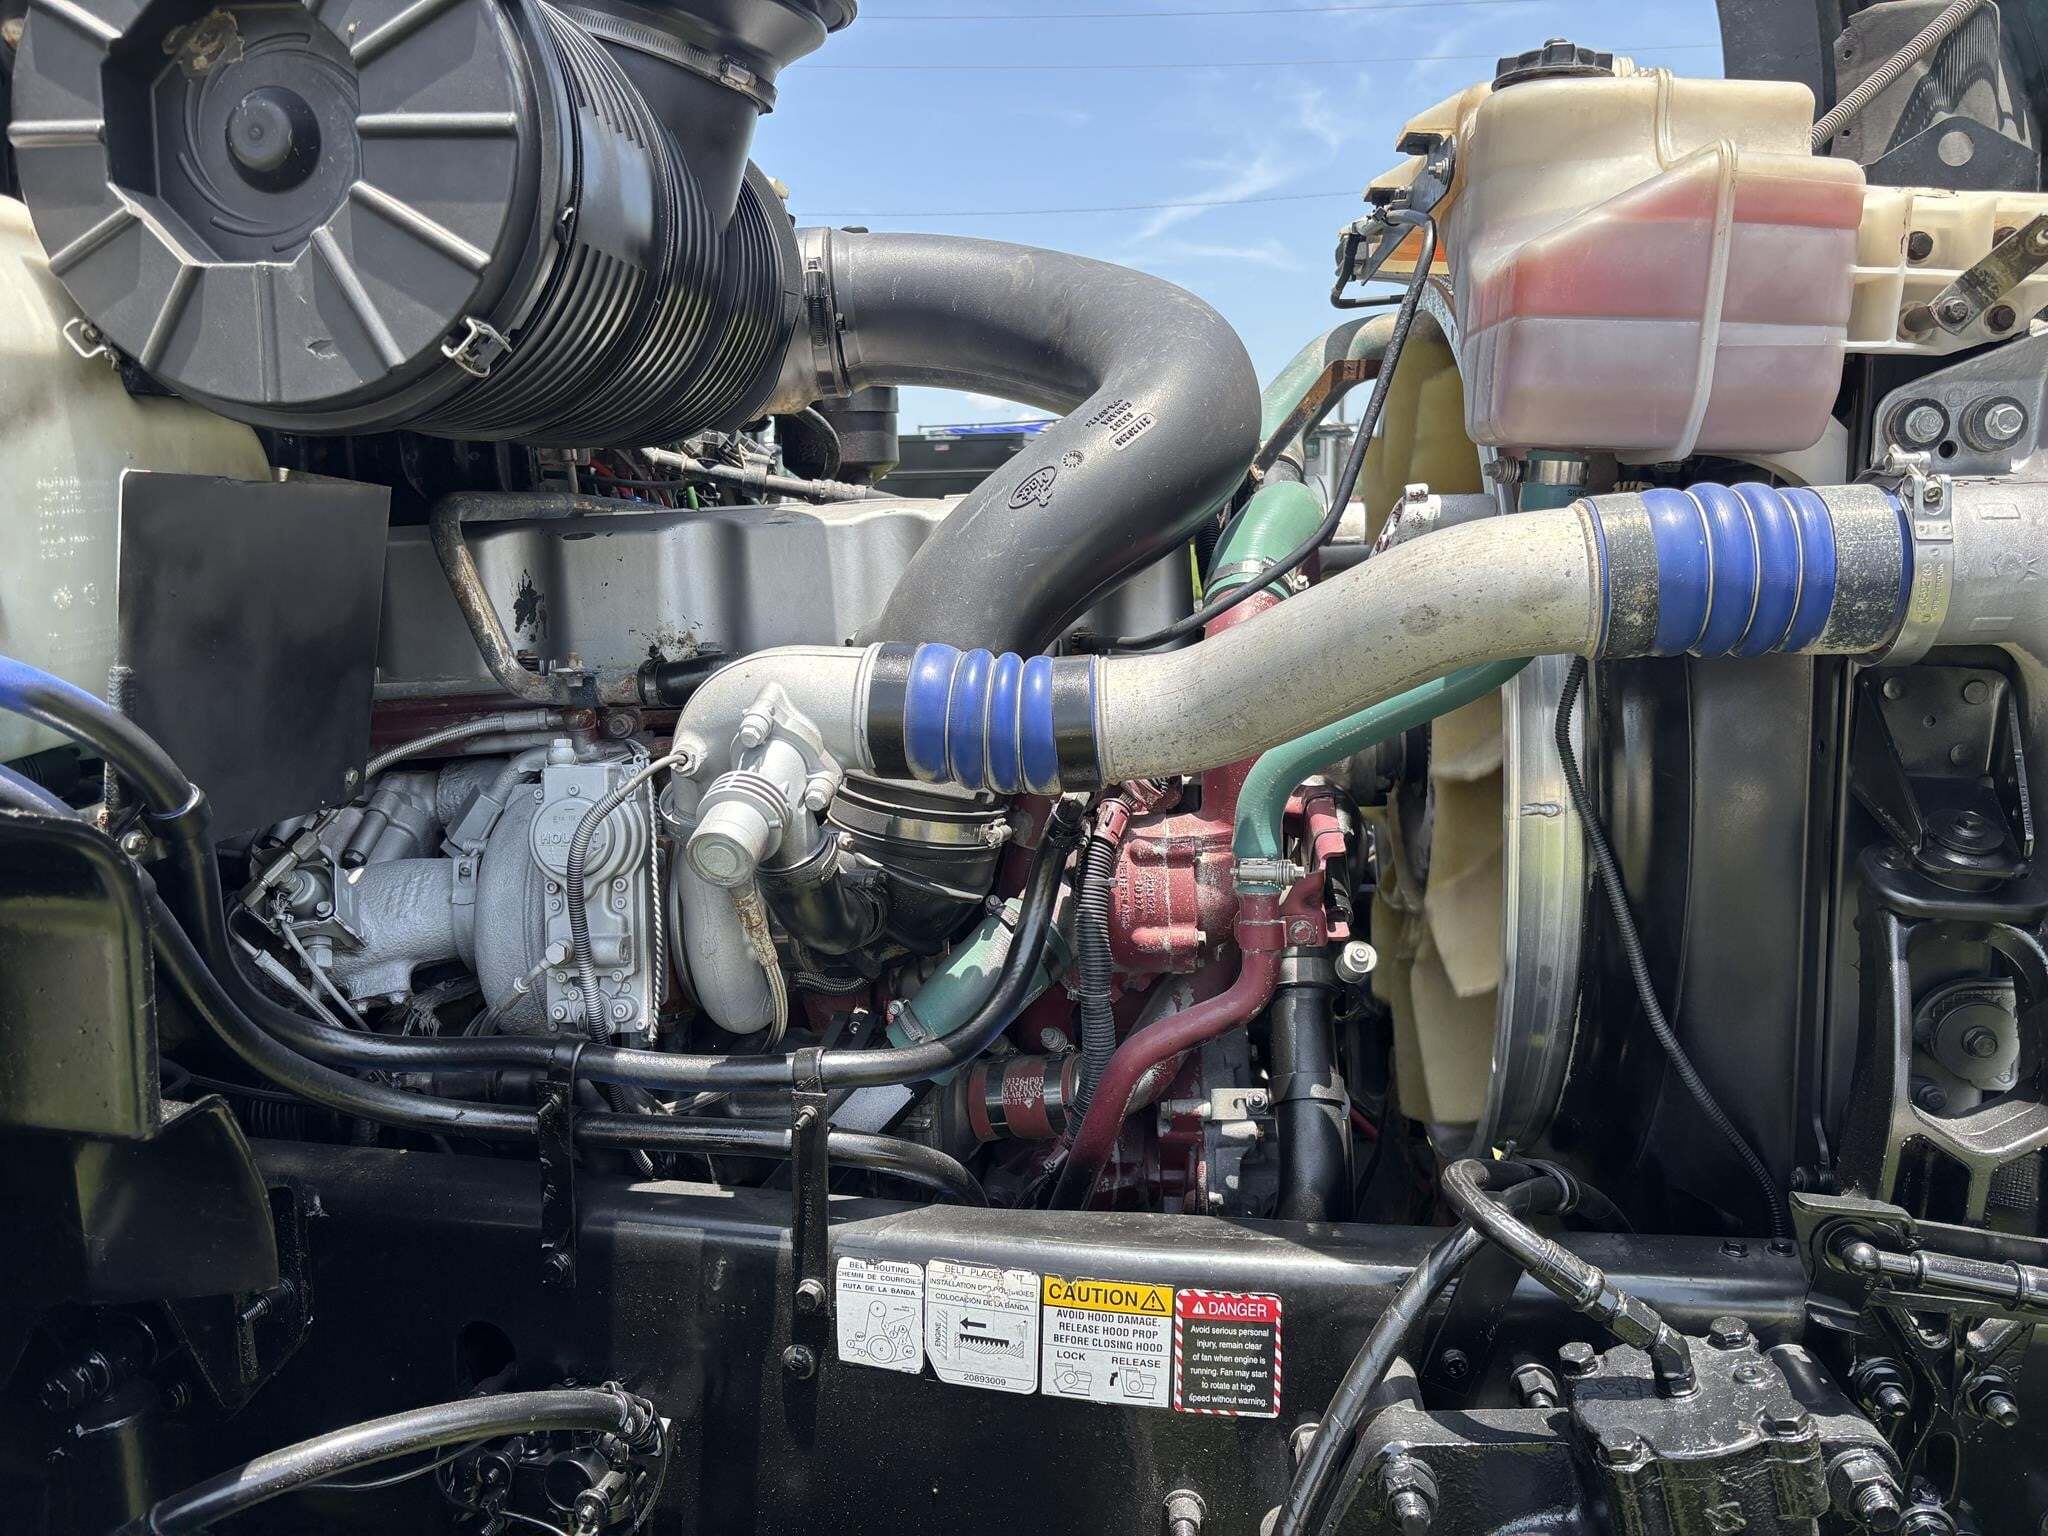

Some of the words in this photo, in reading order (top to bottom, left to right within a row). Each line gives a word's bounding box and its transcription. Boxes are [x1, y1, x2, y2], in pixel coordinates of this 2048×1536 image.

[1100, 402, 1132, 425] CANADA
[944, 1264, 965, 1274] BELT
[838, 1270, 864, 1279] CHEMIN
[867, 1273, 876, 1281] DE
[842, 1282, 861, 1290] RUTA
[890, 1287, 916, 1296] BANDA
[930, 1278, 976, 1290] INSTALLATION
[1049, 1283, 1138, 1307] CAUTION
[1005, 1302, 1030, 1311] BANDA
[1208, 1301, 1267, 1318] DANGER
[1057, 1309, 1084, 1320] AVOID
[1087, 1312, 1114, 1322] HOOD
[1118, 1315, 1161, 1327] DAMAGE.
[1059, 1322, 1100, 1334] RELEASE
[1103, 1327, 1129, 1337] HOOD
[1132, 1330, 1158, 1340] PROP
[1190, 1325, 1210, 1334] Avoid
[1211, 1327, 1237, 1335] serious
[1238, 1328, 1269, 1337] personal
[1053, 1333, 1089, 1346] BEFORE
[1092, 1338, 1133, 1350] CLOSING
[1136, 1342, 1163, 1353] HOOD
[1218, 1341, 1243, 1349] remain
[1244, 1341, 1262, 1350] clear
[1056, 1350, 1086, 1361] LOCK
[1201, 1353, 1212, 1361] fan
[1214, 1354, 1232, 1362] when
[1234, 1356, 1258, 1365] engine
[1259, 1356, 1266, 1364] is
[1111, 1356, 1161, 1369] RELEASE
[1190, 1367, 1218, 1377] running.
[1220, 1367, 1233, 1376] Fan
[1235, 1370, 1250, 1379] may
[1251, 1370, 1268, 1378] start
[963, 1373, 1006, 1386] 20893009
[1201, 1381, 1209, 1389] to
[1210, 1381, 1230, 1390] rotate
[1231, 1382, 1239, 1390] at
[1240, 1383, 1256, 1392] high
[1211, 1394, 1237, 1404] without
[1238, 1397, 1268, 1407] warning.
